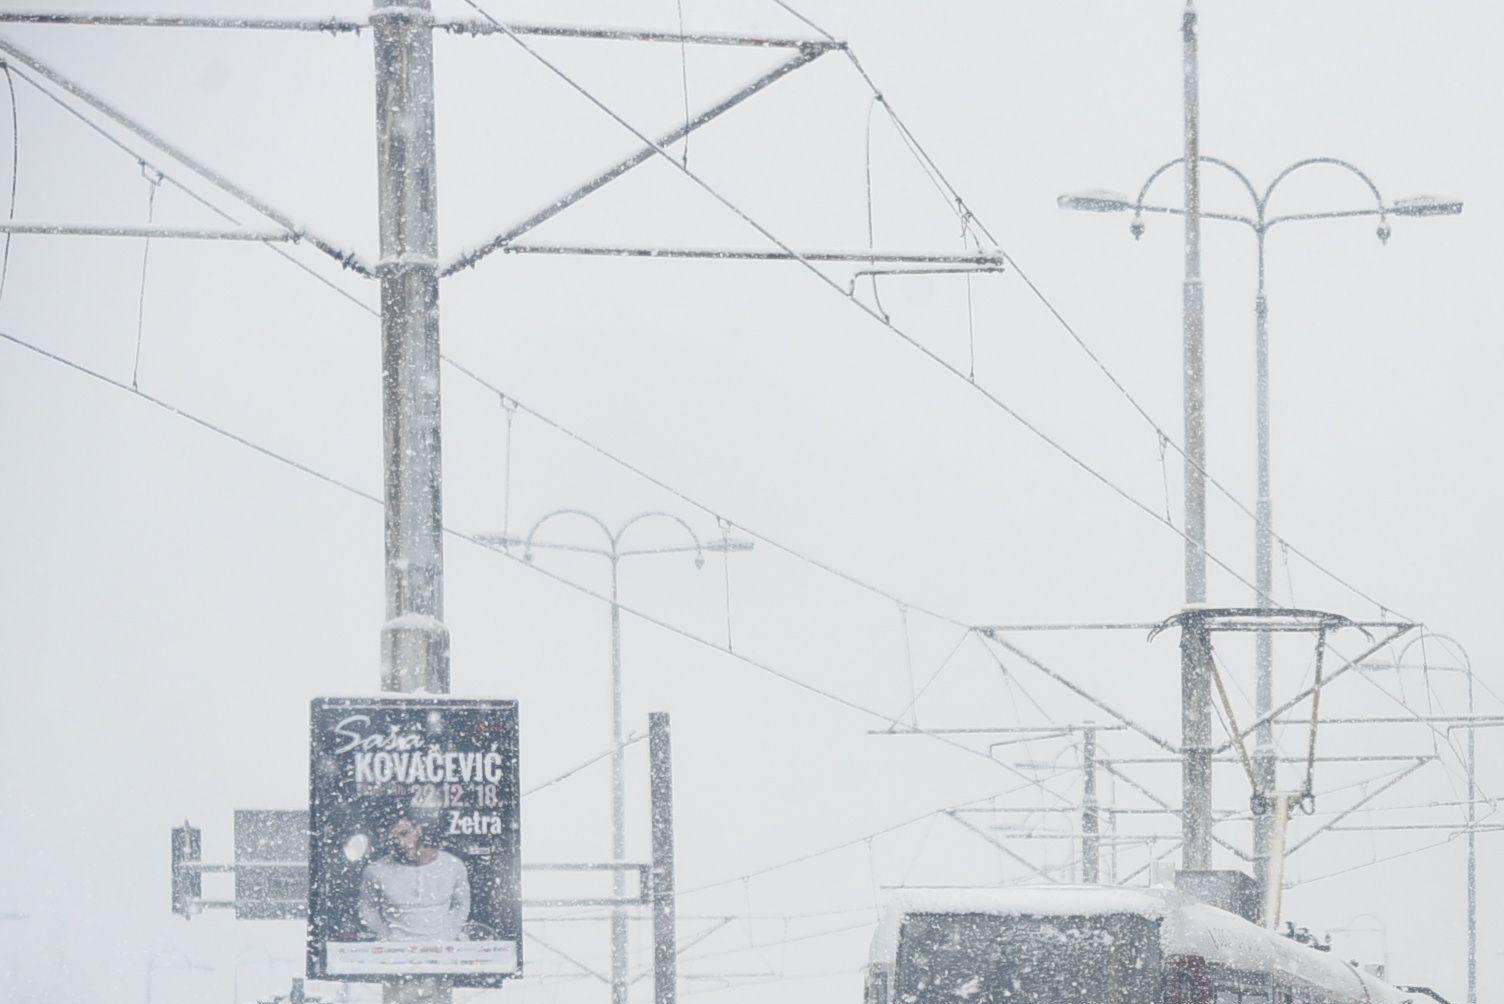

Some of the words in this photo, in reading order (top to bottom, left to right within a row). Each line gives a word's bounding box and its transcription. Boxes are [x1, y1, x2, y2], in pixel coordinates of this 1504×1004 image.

[332, 714, 425, 755] Saša
[354, 744, 503, 785] KOVAČEVIĆ
[448, 810, 503, 836] Zetra
